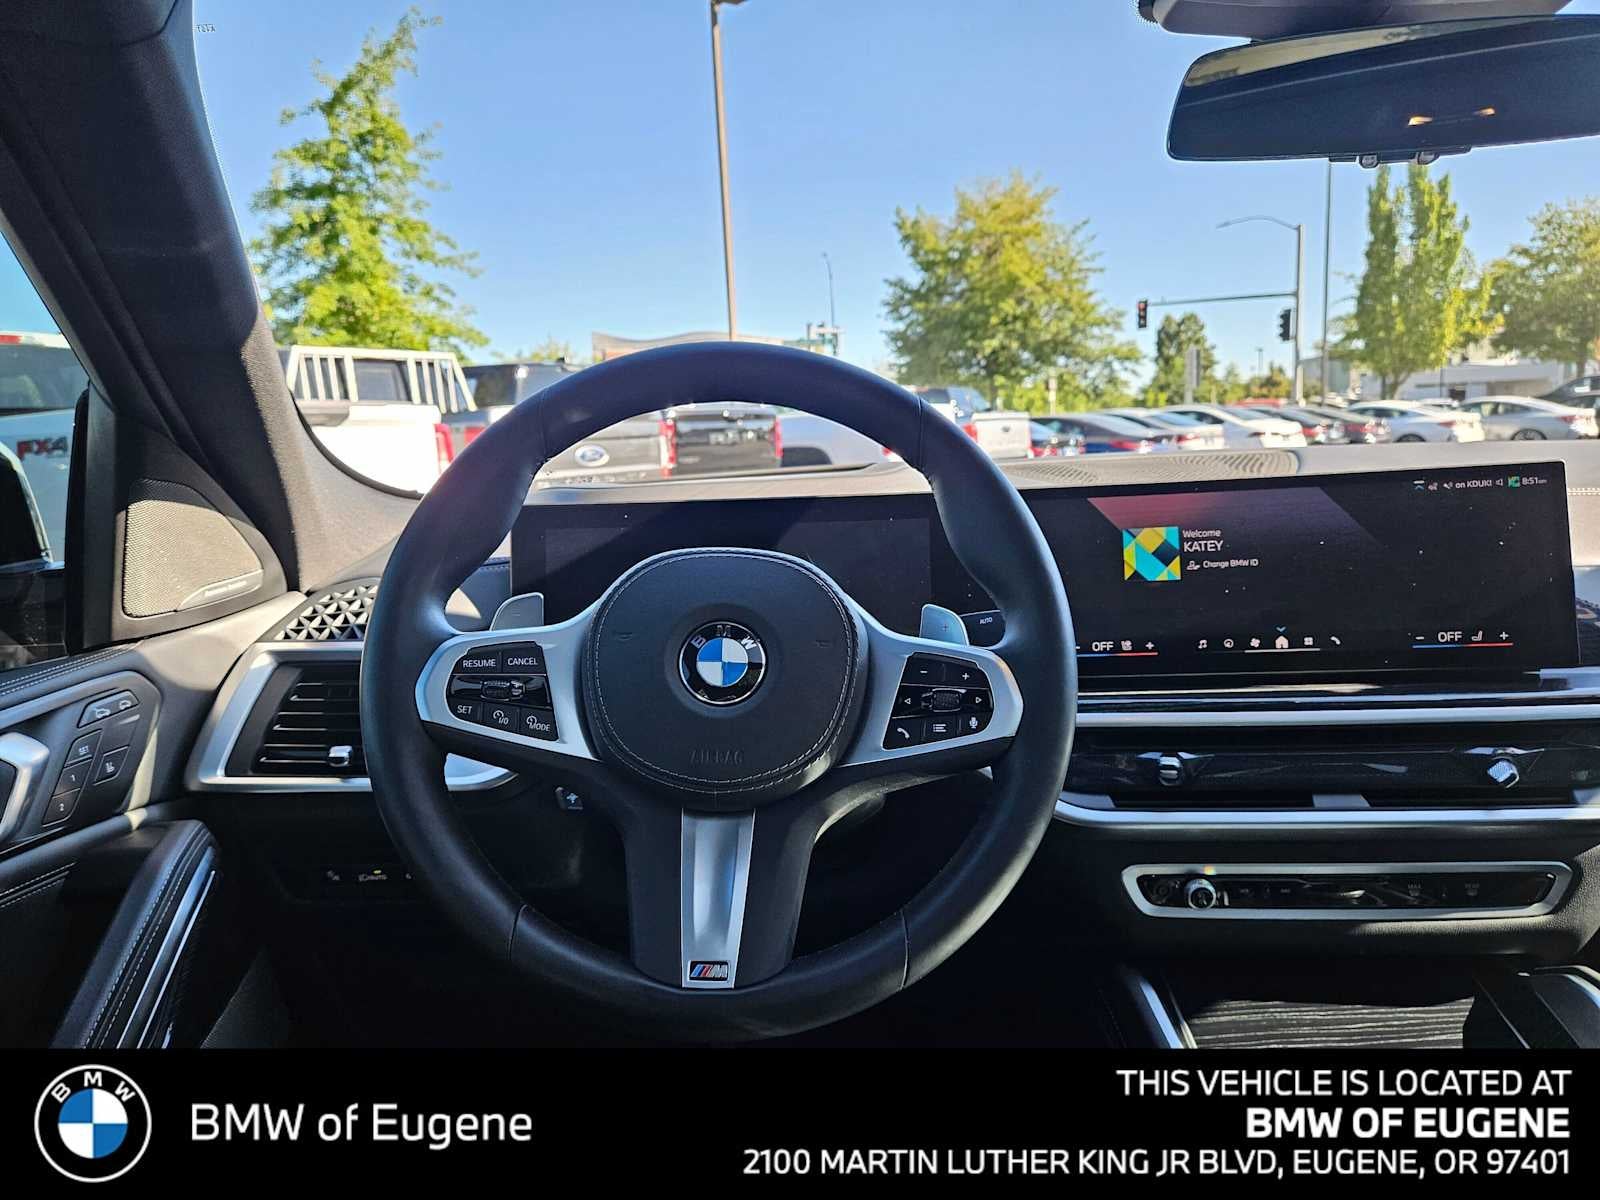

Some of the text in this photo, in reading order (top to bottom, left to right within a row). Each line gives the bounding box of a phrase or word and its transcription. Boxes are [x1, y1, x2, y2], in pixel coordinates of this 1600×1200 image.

[17, 436, 68, 461] FX4
[1182, 529, 1221, 538] Welcome
[1183, 540, 1223, 552] KATEY
[1203, 558, 1259, 569] Change BMW ID
[1438, 631, 1462, 642] OFF
[1092, 641, 1114, 652] OFF
[462, 658, 496, 668] RESUME
[507, 657, 538, 666] CANCEL
[457, 705, 473, 714] SET
[528, 722, 551, 732] MODE
